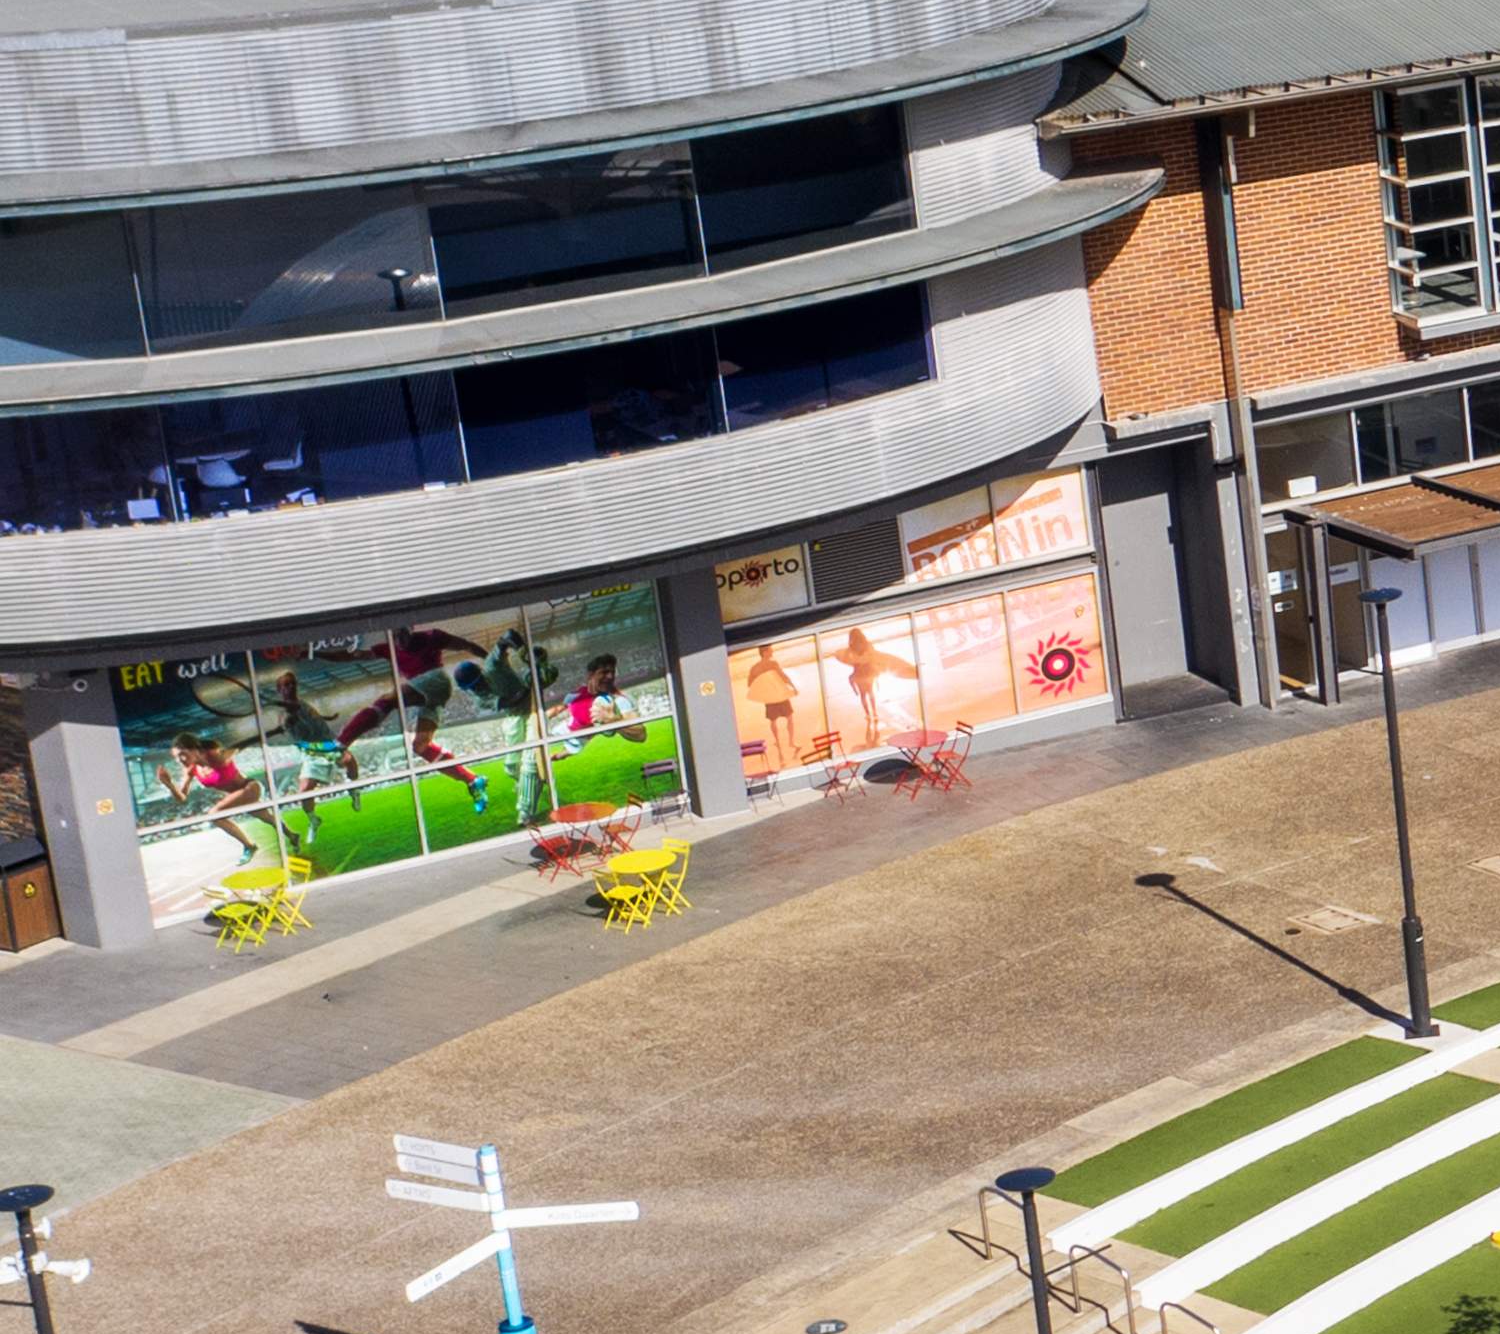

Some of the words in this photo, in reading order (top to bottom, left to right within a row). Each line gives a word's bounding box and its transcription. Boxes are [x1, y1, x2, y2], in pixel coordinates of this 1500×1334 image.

[911, 516, 1031, 584] BORN
[1031, 515, 1073, 553] in
[716, 556, 800, 592] oporto
[120, 660, 165, 691] EAT
[178, 651, 230, 679] well
